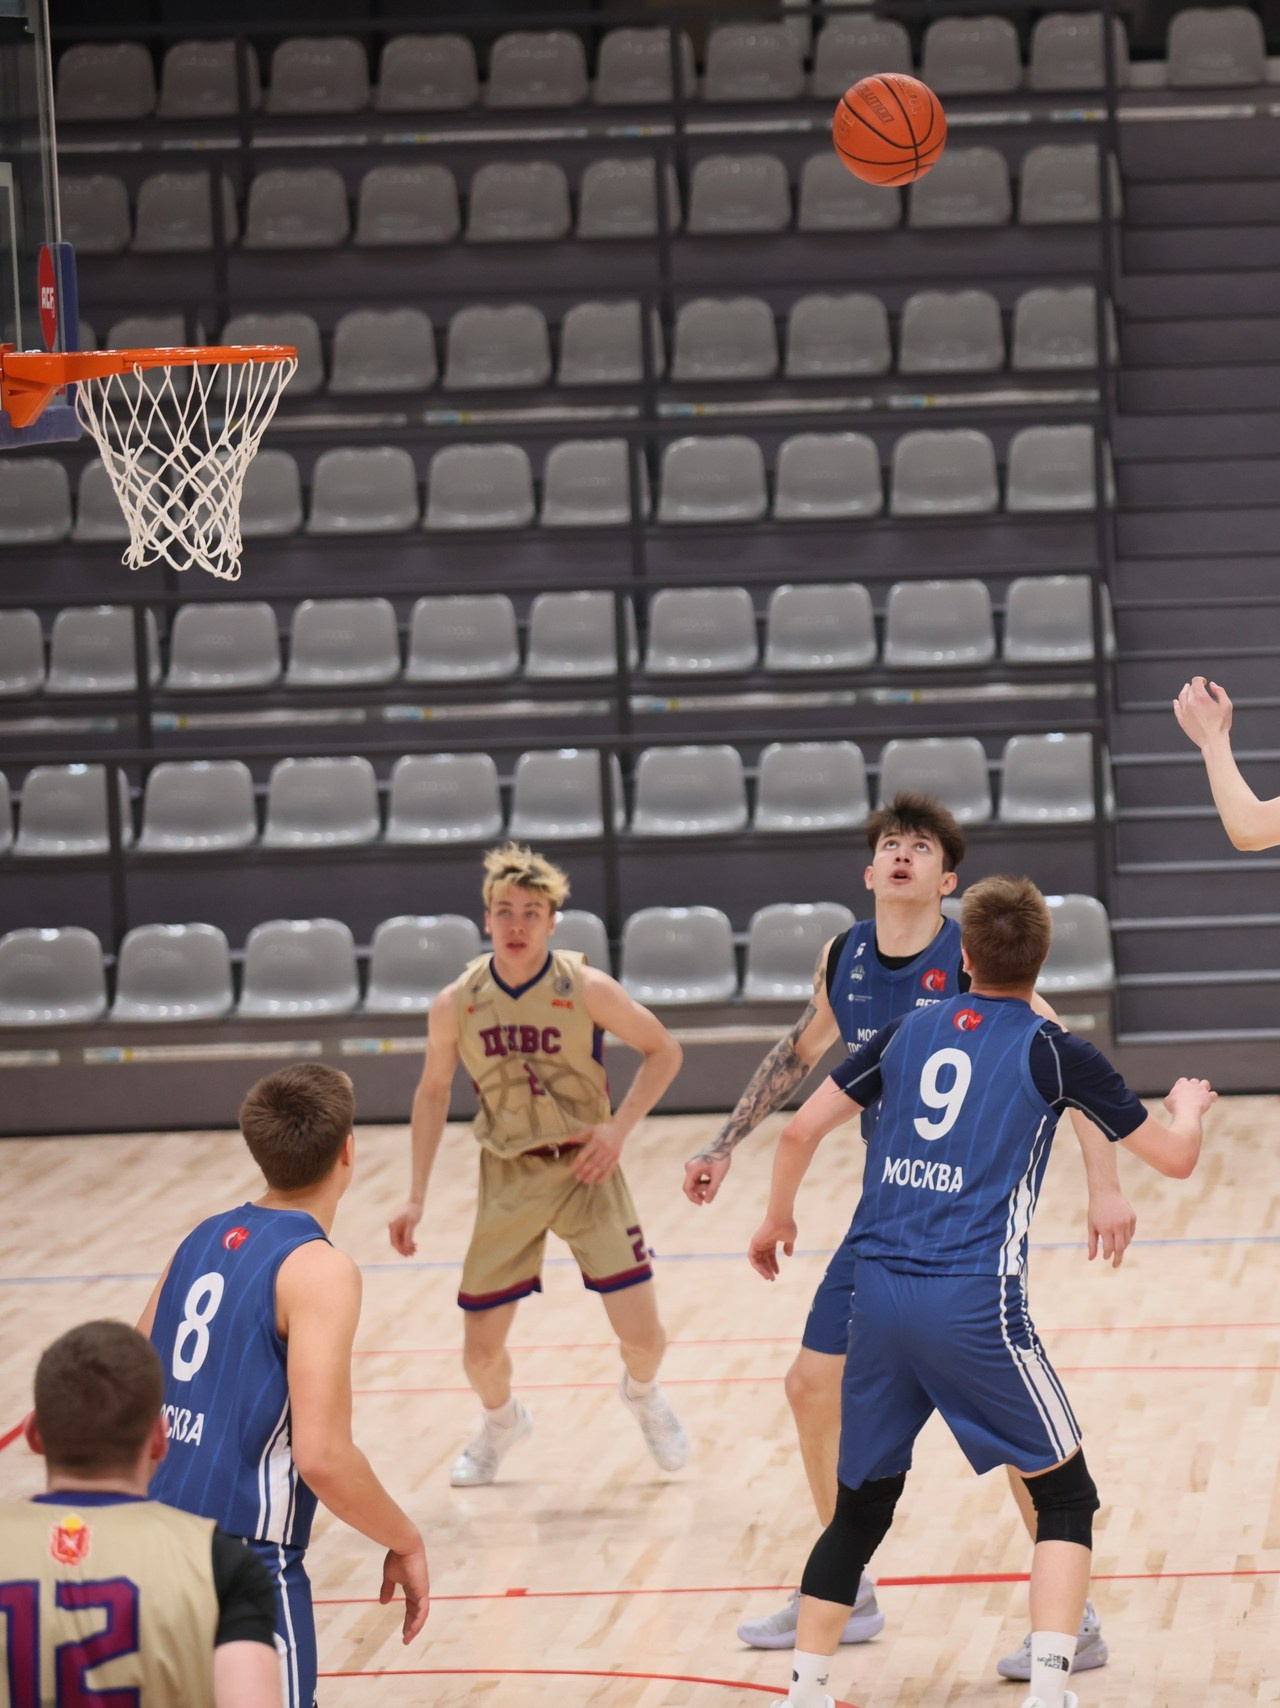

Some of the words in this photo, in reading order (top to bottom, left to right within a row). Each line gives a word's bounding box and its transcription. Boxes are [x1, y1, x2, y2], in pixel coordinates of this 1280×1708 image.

[913, 1047, 972, 1141] 9
[881, 1156, 963, 1194] МОСКВА
[172, 1271, 225, 1382] 8
[0, 1576, 142, 1708] 12
